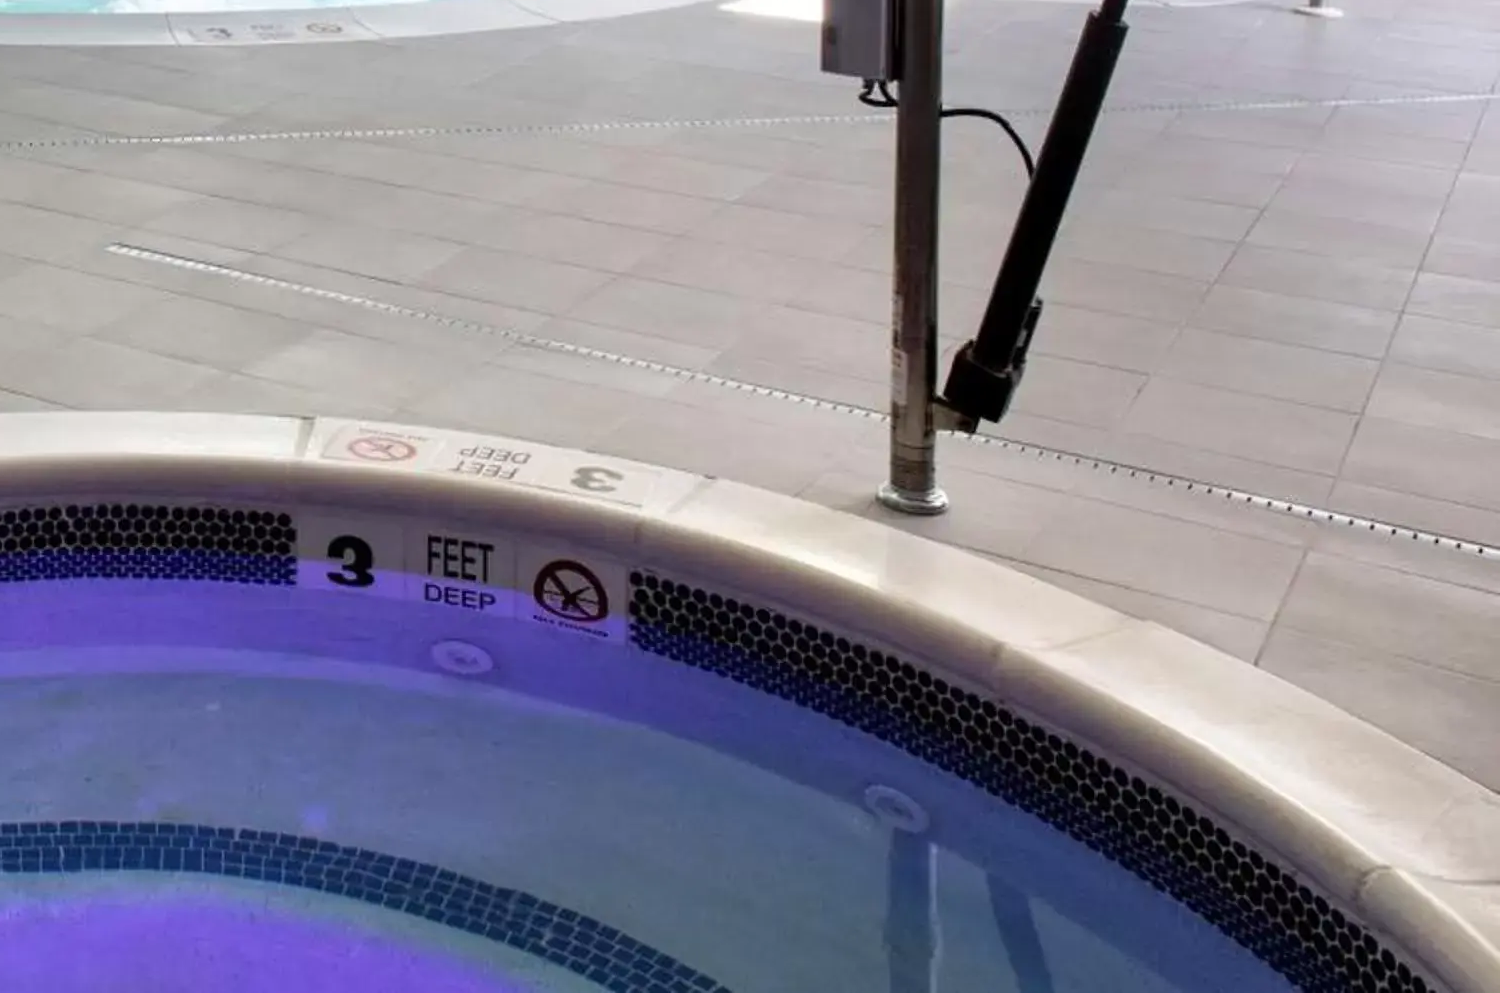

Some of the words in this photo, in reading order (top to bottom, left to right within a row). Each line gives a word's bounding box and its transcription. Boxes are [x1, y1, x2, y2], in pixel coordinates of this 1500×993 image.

[459, 446, 532, 466] DEEP
[450, 460, 520, 481] FEET
[570, 466, 624, 493] 3
[326, 534, 375, 587] 3
[426, 534, 495, 584] FEET
[423, 583, 496, 611] DEEP
